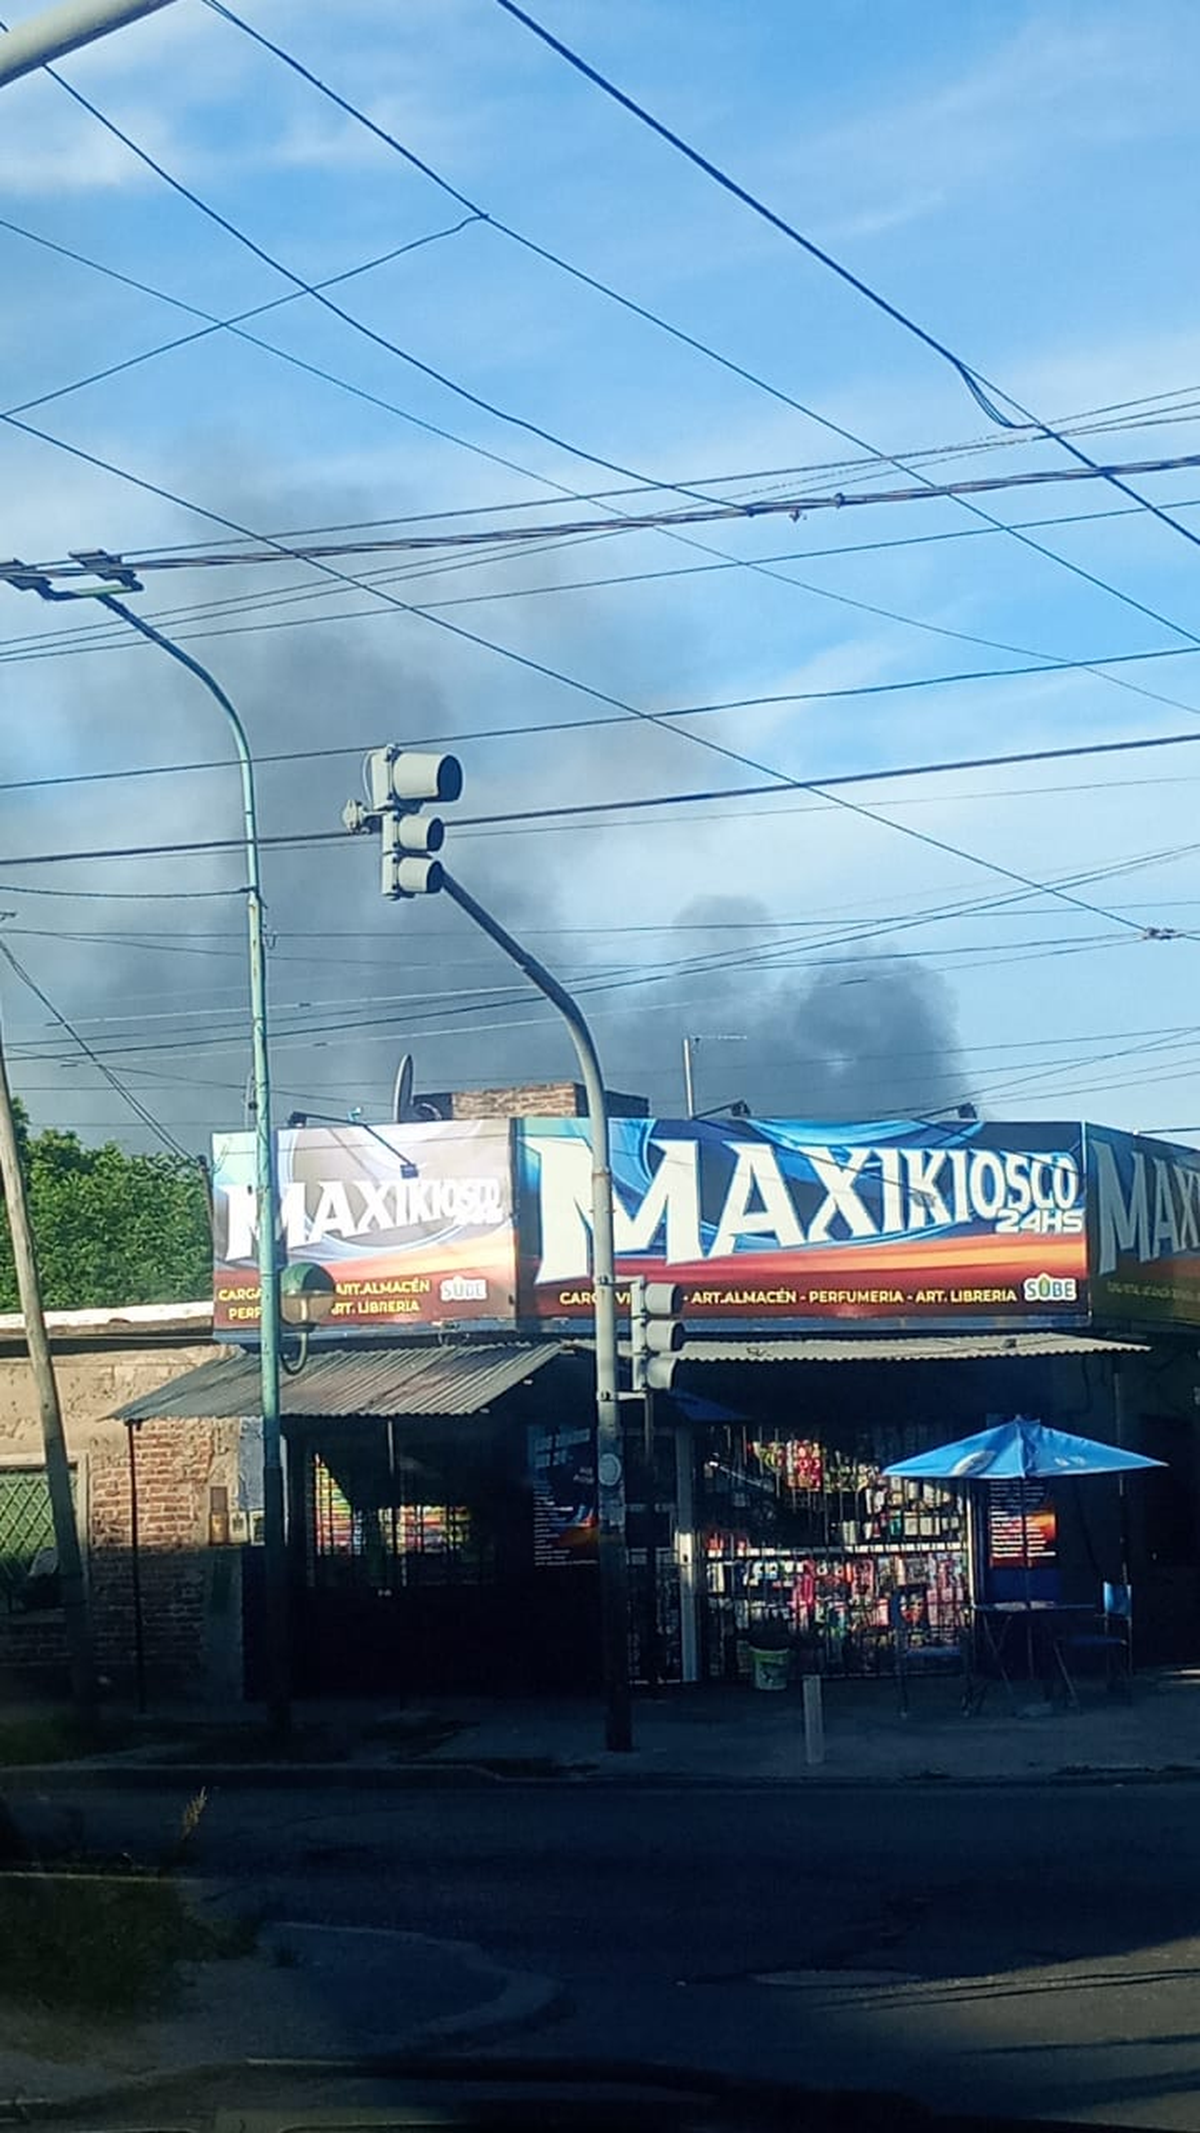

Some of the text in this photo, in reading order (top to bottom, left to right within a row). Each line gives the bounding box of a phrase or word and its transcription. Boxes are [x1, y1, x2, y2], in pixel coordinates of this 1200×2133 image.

[526, 1137, 1077, 1284] MAXIKIOSCO
[995, 1209, 1082, 1233] 24HS
[691, 1287, 796, 1305] ART.ALMACÉN
[809, 1290, 903, 1304] PERFUMERIA
[915, 1290, 948, 1304] ART.
[951, 1290, 1017, 1303] LIBRERIA
[1025, 1277, 1075, 1300] SUBE
